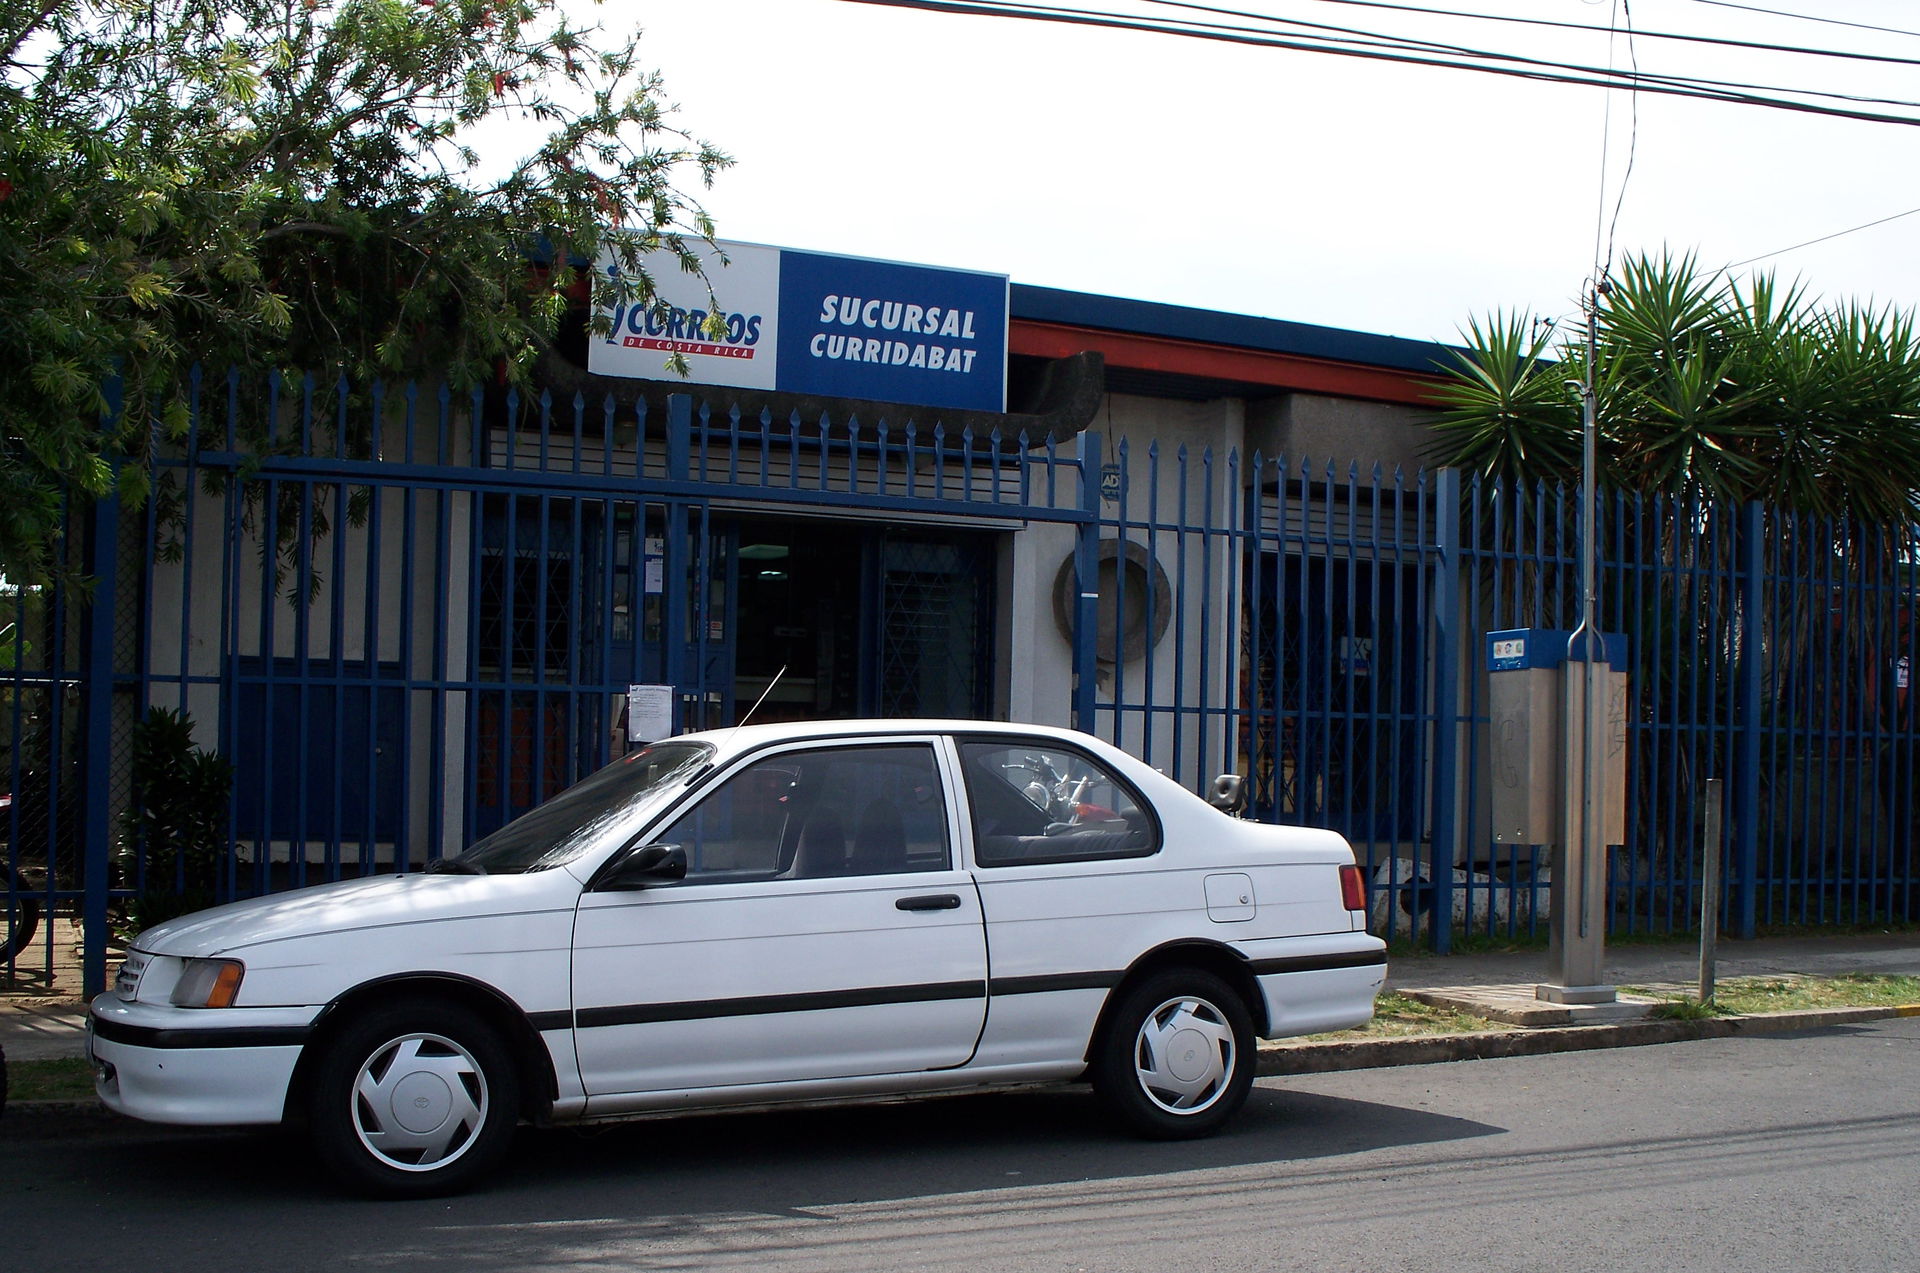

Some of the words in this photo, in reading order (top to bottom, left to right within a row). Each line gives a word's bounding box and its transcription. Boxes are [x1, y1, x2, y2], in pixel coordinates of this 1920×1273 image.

[819, 294, 976, 340] SUCURSAL
[627, 337, 645, 348] DE
[656, 341, 702, 353] COSTA
[713, 346, 749, 358] RICA
[809, 333, 977, 374] CURRIDABAT
